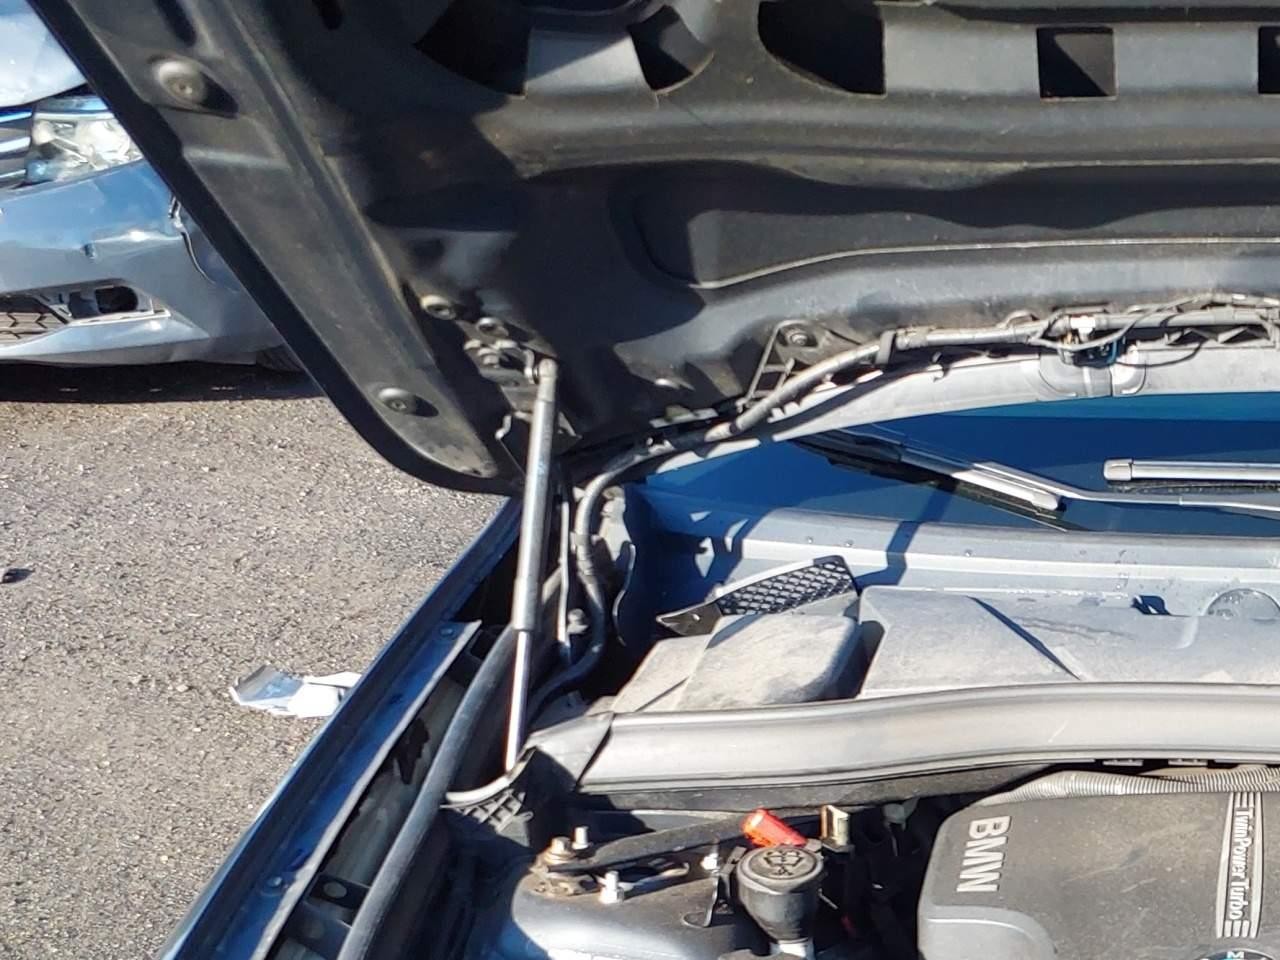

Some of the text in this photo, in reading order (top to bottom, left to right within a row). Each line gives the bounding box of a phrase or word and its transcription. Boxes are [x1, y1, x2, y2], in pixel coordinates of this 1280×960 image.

[956, 815, 1011, 893] BMW
[1229, 810, 1254, 921] TwinPower Turbo
